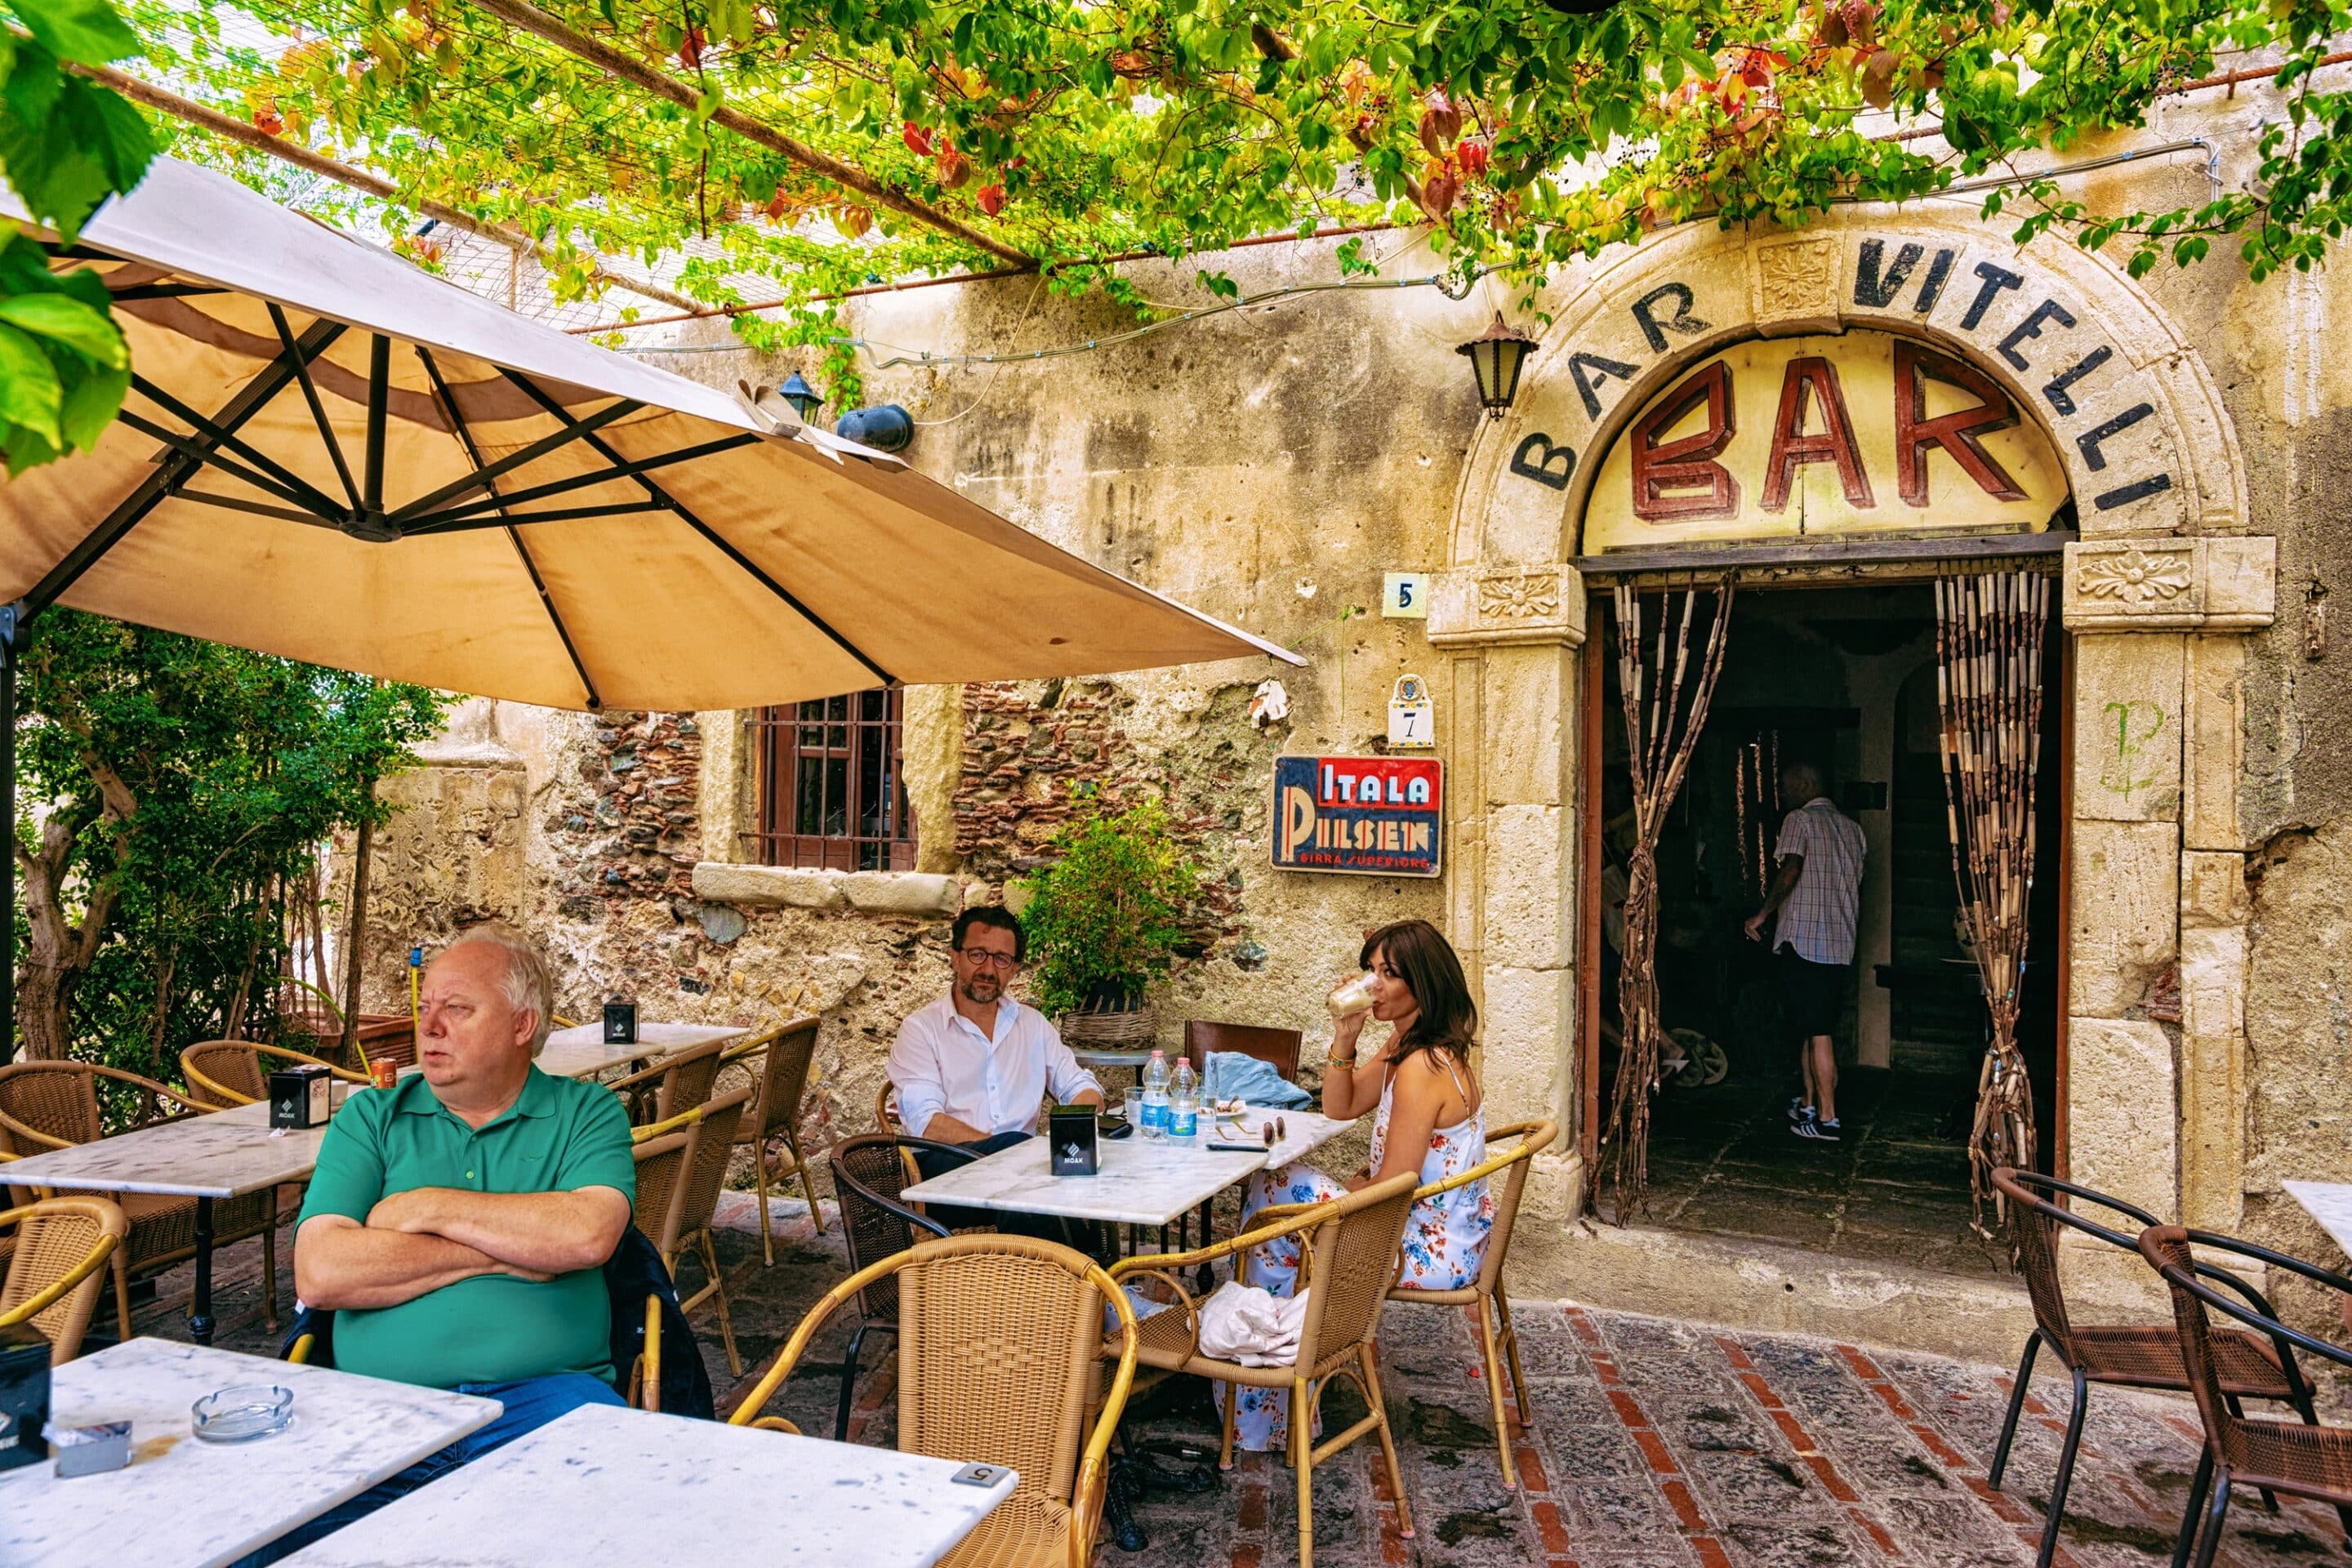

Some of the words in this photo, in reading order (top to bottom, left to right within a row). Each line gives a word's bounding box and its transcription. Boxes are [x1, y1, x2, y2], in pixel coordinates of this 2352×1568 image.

[1509, 282, 1711, 492] BAR
[1854, 238, 2172, 511] VITELLI
[1632, 340, 2030, 523] BAR
[1399, 583, 1413, 608] 5
[1404, 713, 1416, 737] 7
[1321, 764, 1429, 804] ITALA
[1280, 786, 1429, 862] PILSEN
[1299, 853, 1342, 863] BIRRA
[1346, 857, 1429, 869] SUPERIORE
[967, 1468, 993, 1481] 5
